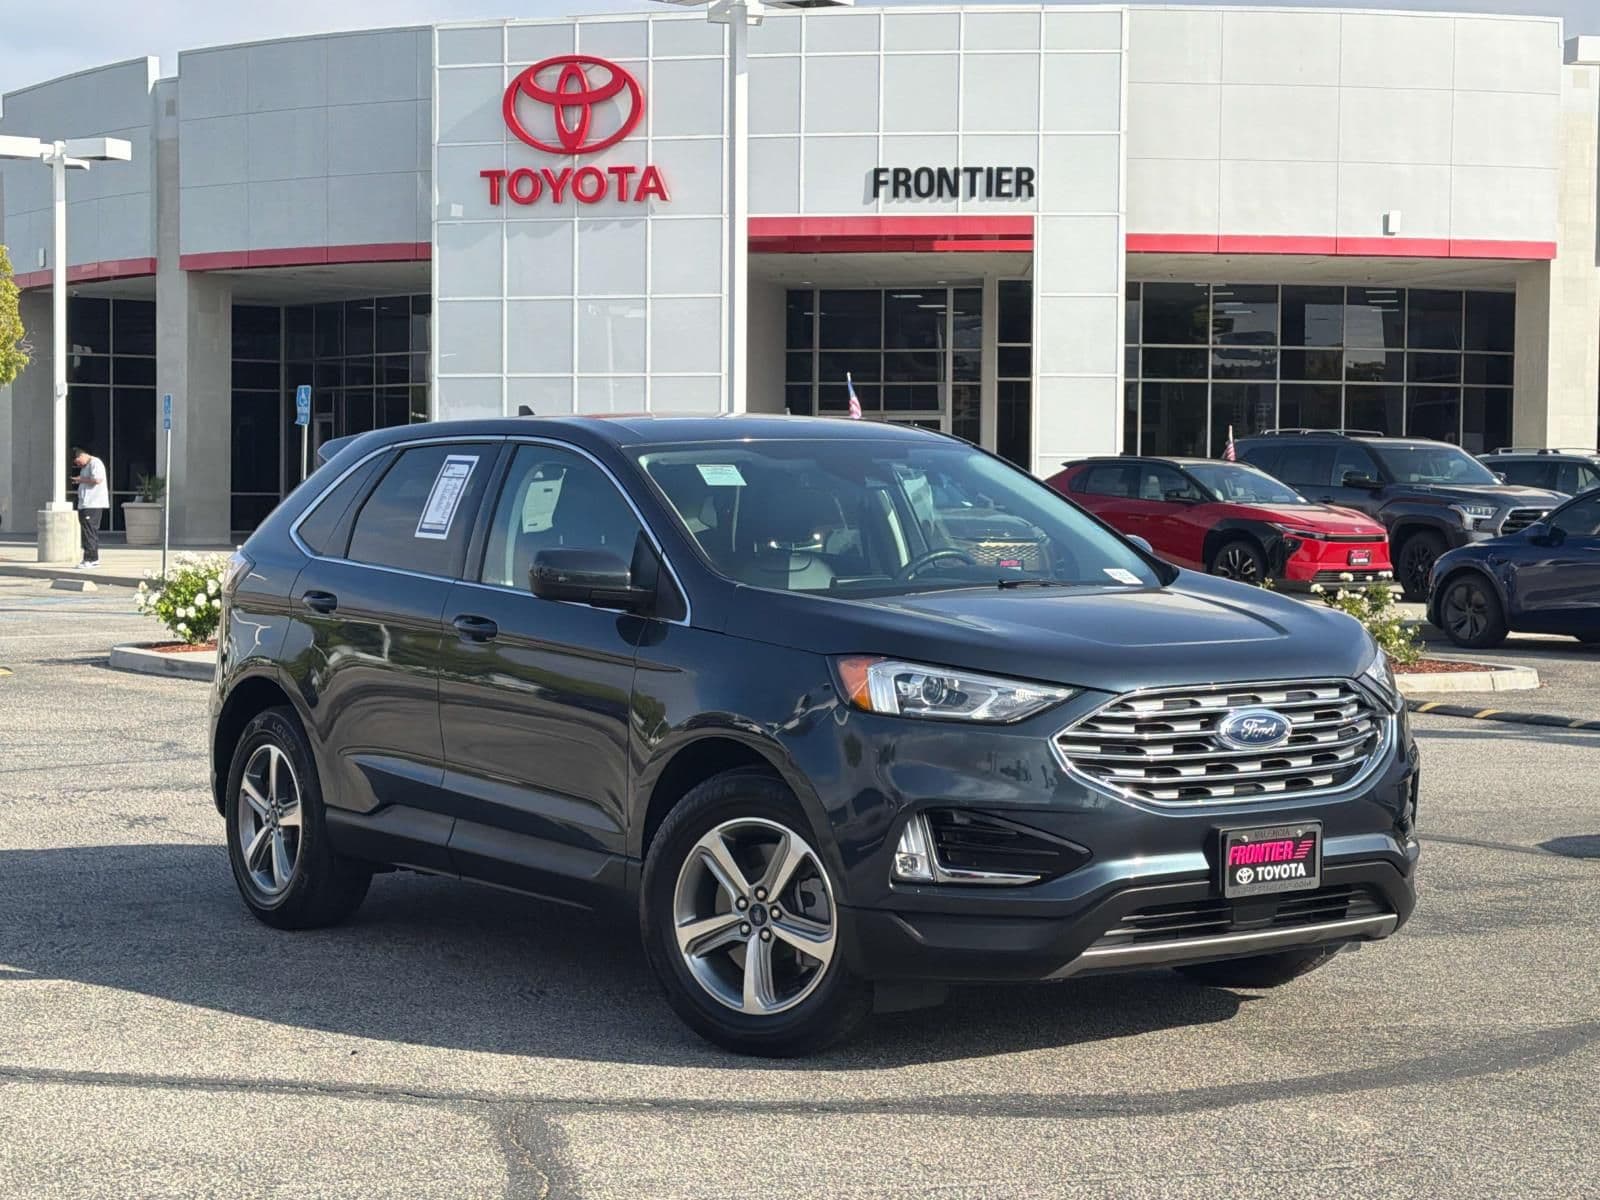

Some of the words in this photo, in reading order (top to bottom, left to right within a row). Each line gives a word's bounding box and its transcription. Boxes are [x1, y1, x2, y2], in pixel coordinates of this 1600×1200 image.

[480, 165, 671, 206] TOYOTA
[872, 166, 1035, 199] FRONTIER
[1241, 718, 1277, 740] Ford
[1228, 840, 1294, 866] FRONTIER
[1256, 863, 1306, 881] TOYOTA
